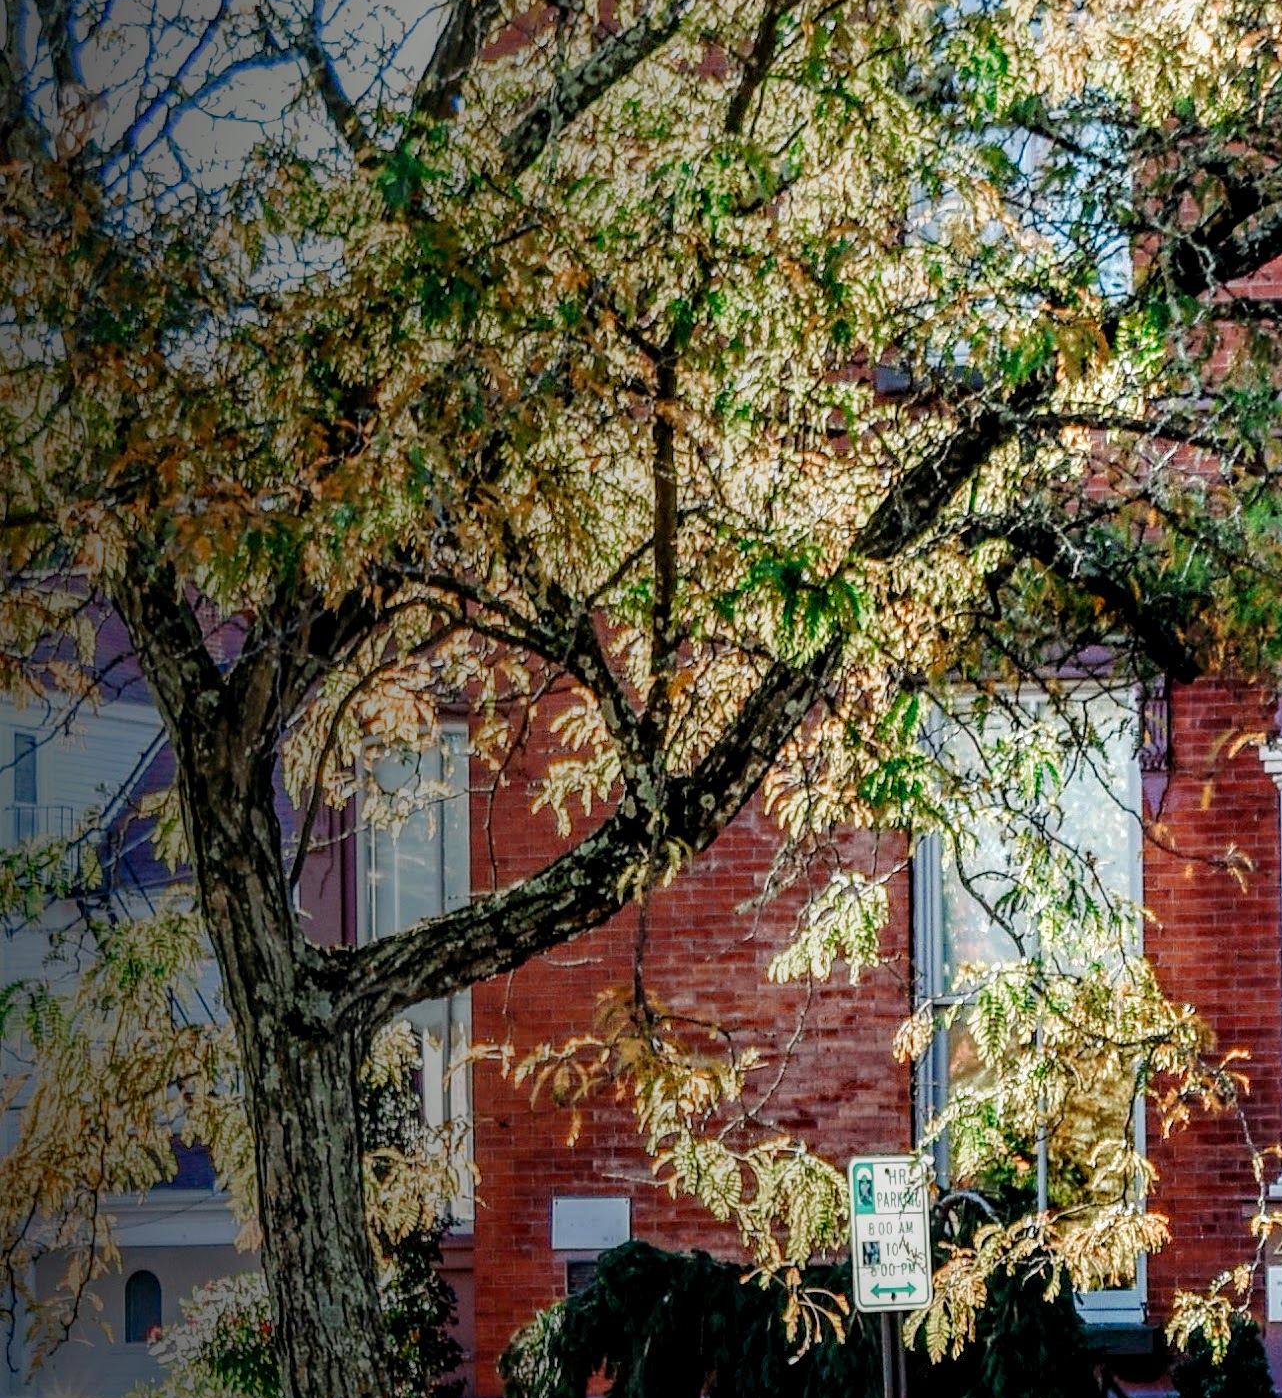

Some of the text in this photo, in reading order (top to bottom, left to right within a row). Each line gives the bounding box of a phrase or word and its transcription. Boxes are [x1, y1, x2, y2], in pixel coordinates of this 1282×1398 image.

[888, 1168, 908, 1185] HR
[898, 1220, 914, 1234] AM
[901, 1262, 916, 1276] PM
